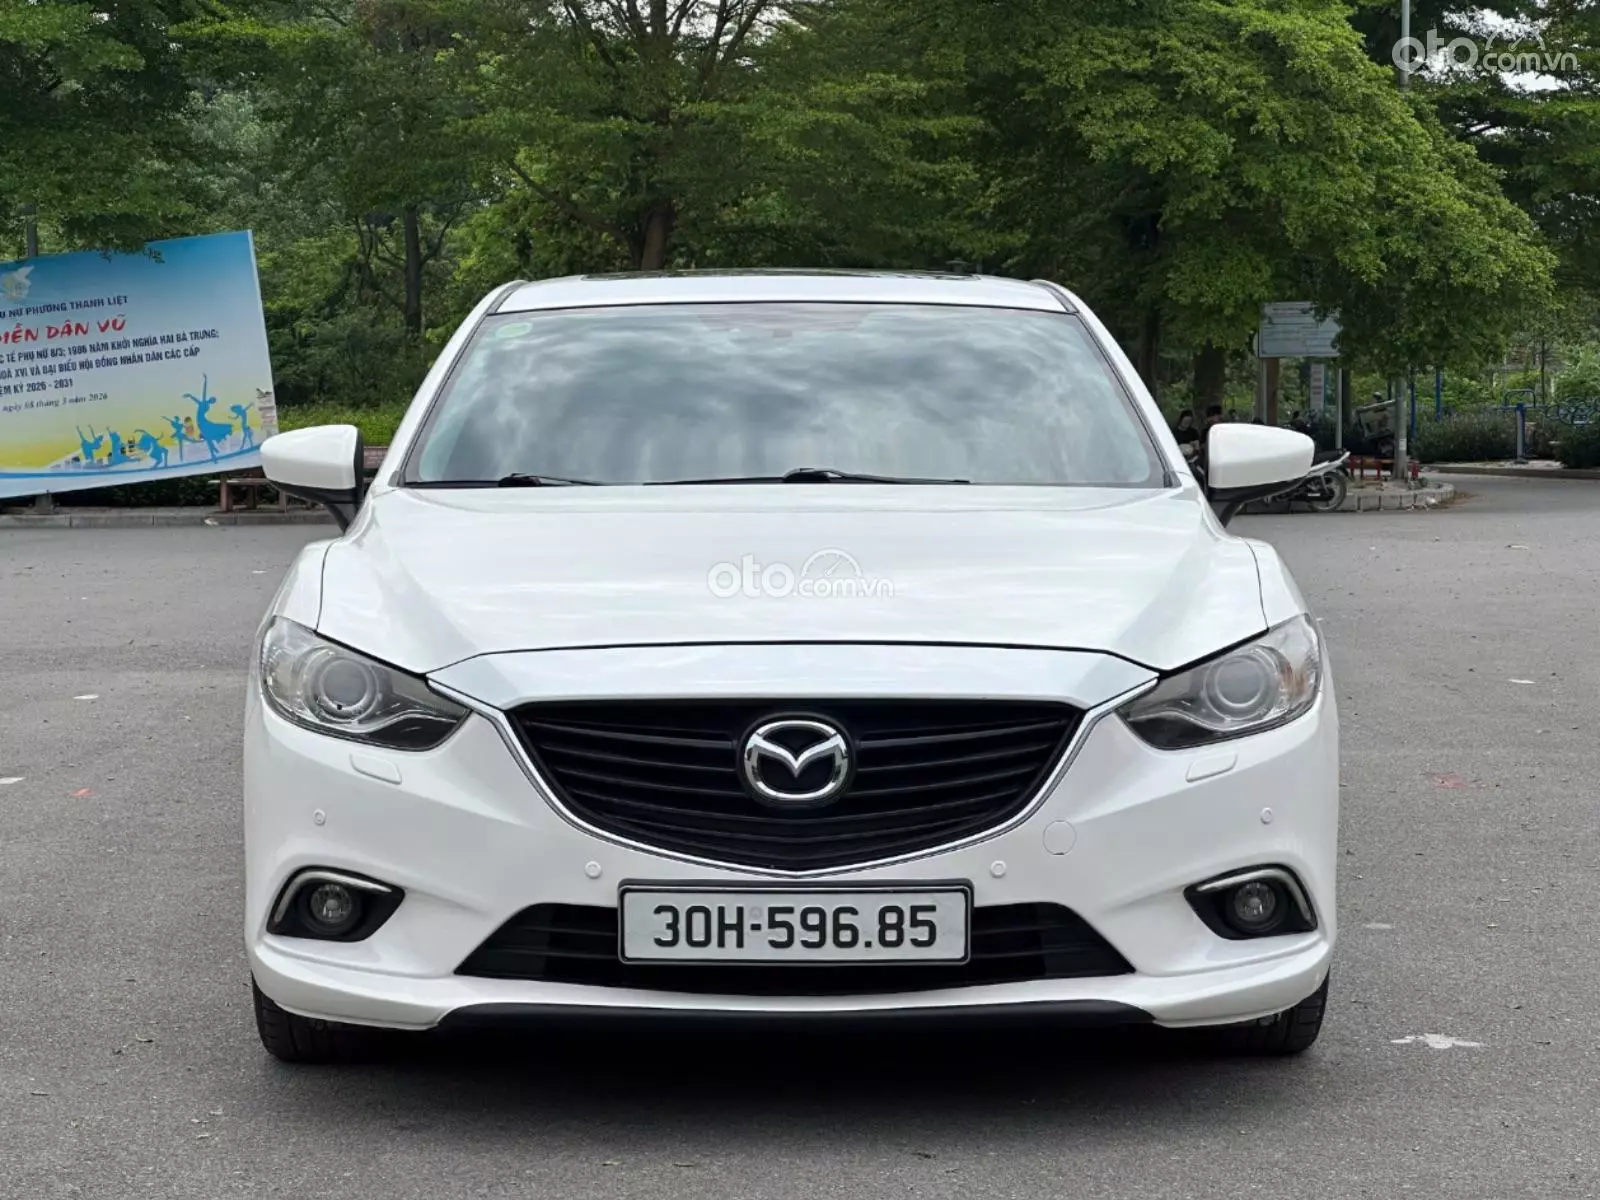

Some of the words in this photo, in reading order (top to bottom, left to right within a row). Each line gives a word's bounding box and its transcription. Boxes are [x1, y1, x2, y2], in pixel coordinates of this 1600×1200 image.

[69, 298, 105, 310] THANH
[107, 295, 129, 306] LIỆT
[45, 318, 89, 339] DÂN
[97, 313, 126, 333] VŨ
[15, 367, 28, 379] XVI
[30, 363, 41, 377] VÀ
[145, 350, 163, 363] DÂN
[164, 347, 182, 360] CÁC
[26, 381, 47, 393] 2026
[653, 904, 937, 949] 30H-596.85
